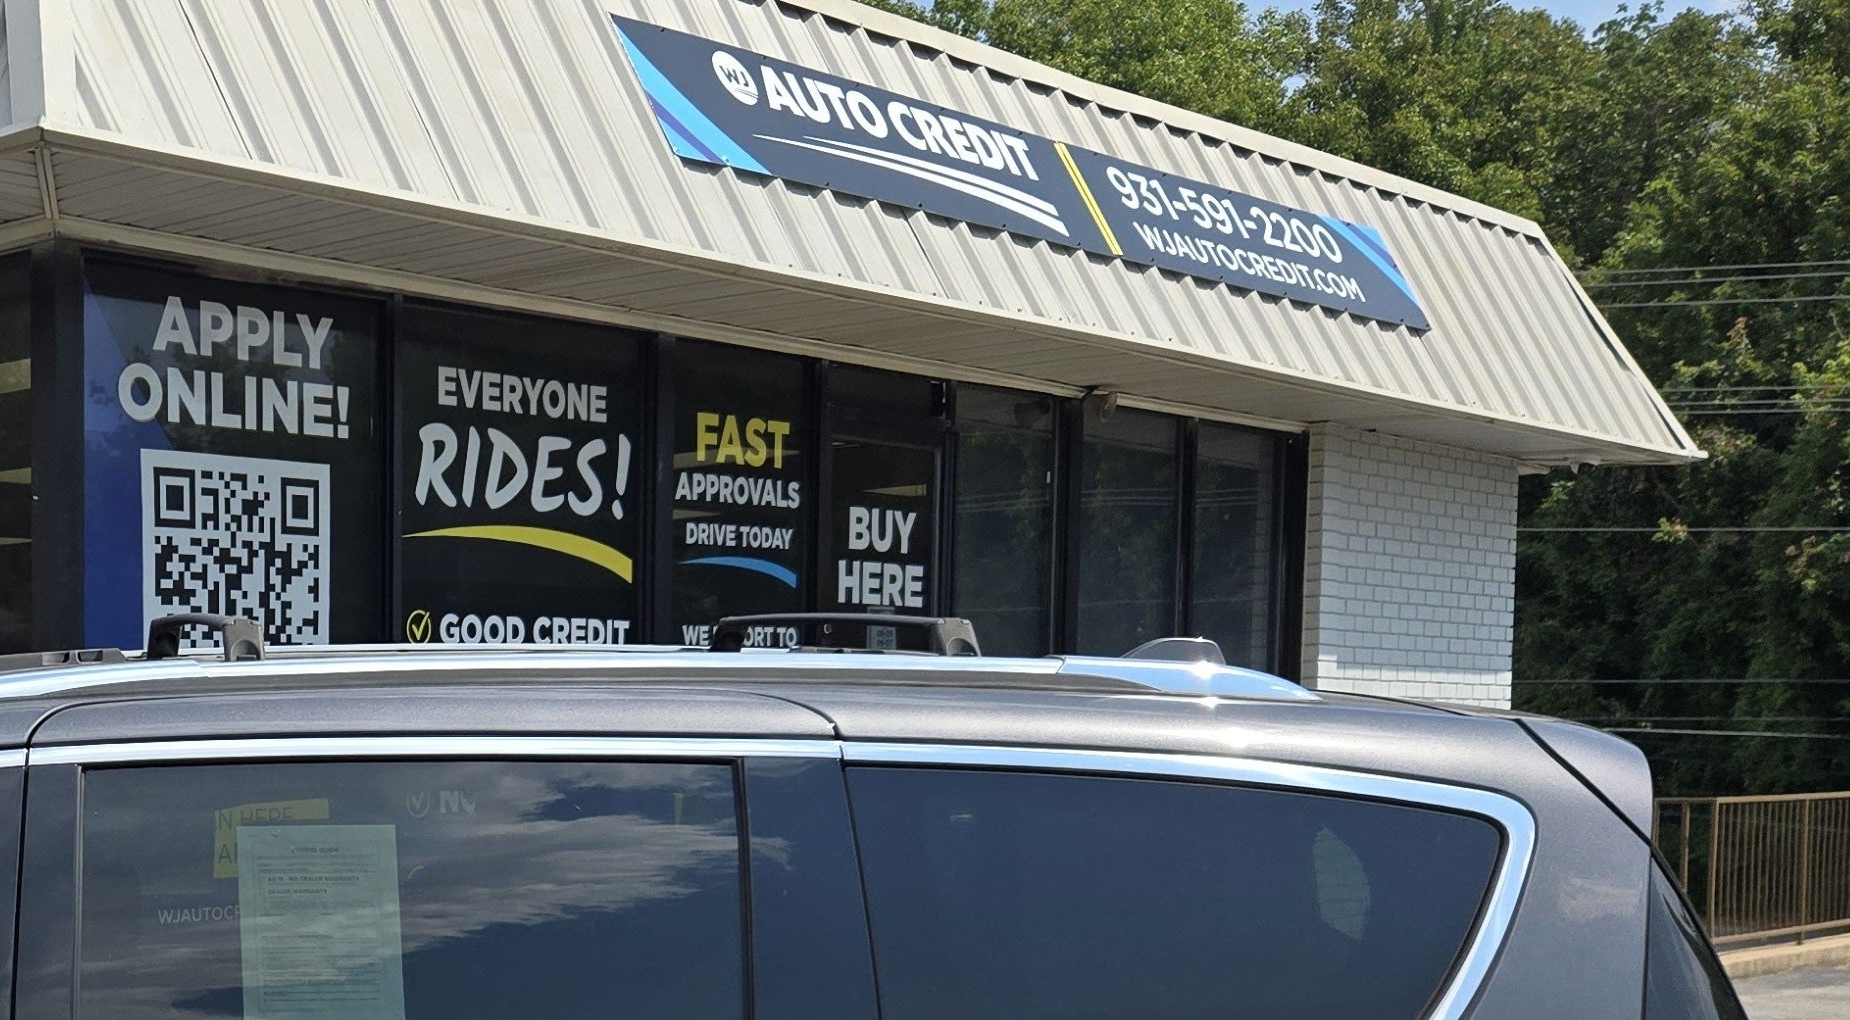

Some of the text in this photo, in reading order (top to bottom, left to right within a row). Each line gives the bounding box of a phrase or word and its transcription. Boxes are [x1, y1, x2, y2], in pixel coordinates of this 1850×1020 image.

[760, 65, 888, 138] AUTO
[888, 101, 1039, 181] CREDIT
[1106, 166, 1343, 263] 931-591-2200
[1133, 222, 1366, 302] WJAUTOCREDIT.COM
[152, 296, 334, 370] APPLY
[117, 362, 350, 439] ONLINE!
[437, 365, 607, 424] EVERYONE
[696, 412, 790, 469] FAST
[414, 422, 632, 521] RIDES!
[674, 471, 800, 510] APPROVALS
[685, 522, 793, 550] DRIVE TODAY
[848, 506, 917, 554] BUY
[837, 560, 924, 608] HERE
[439, 613, 630, 645] GOOD CREDIT
[682, 624, 710, 646] WE
[777, 626, 798, 647] TO
